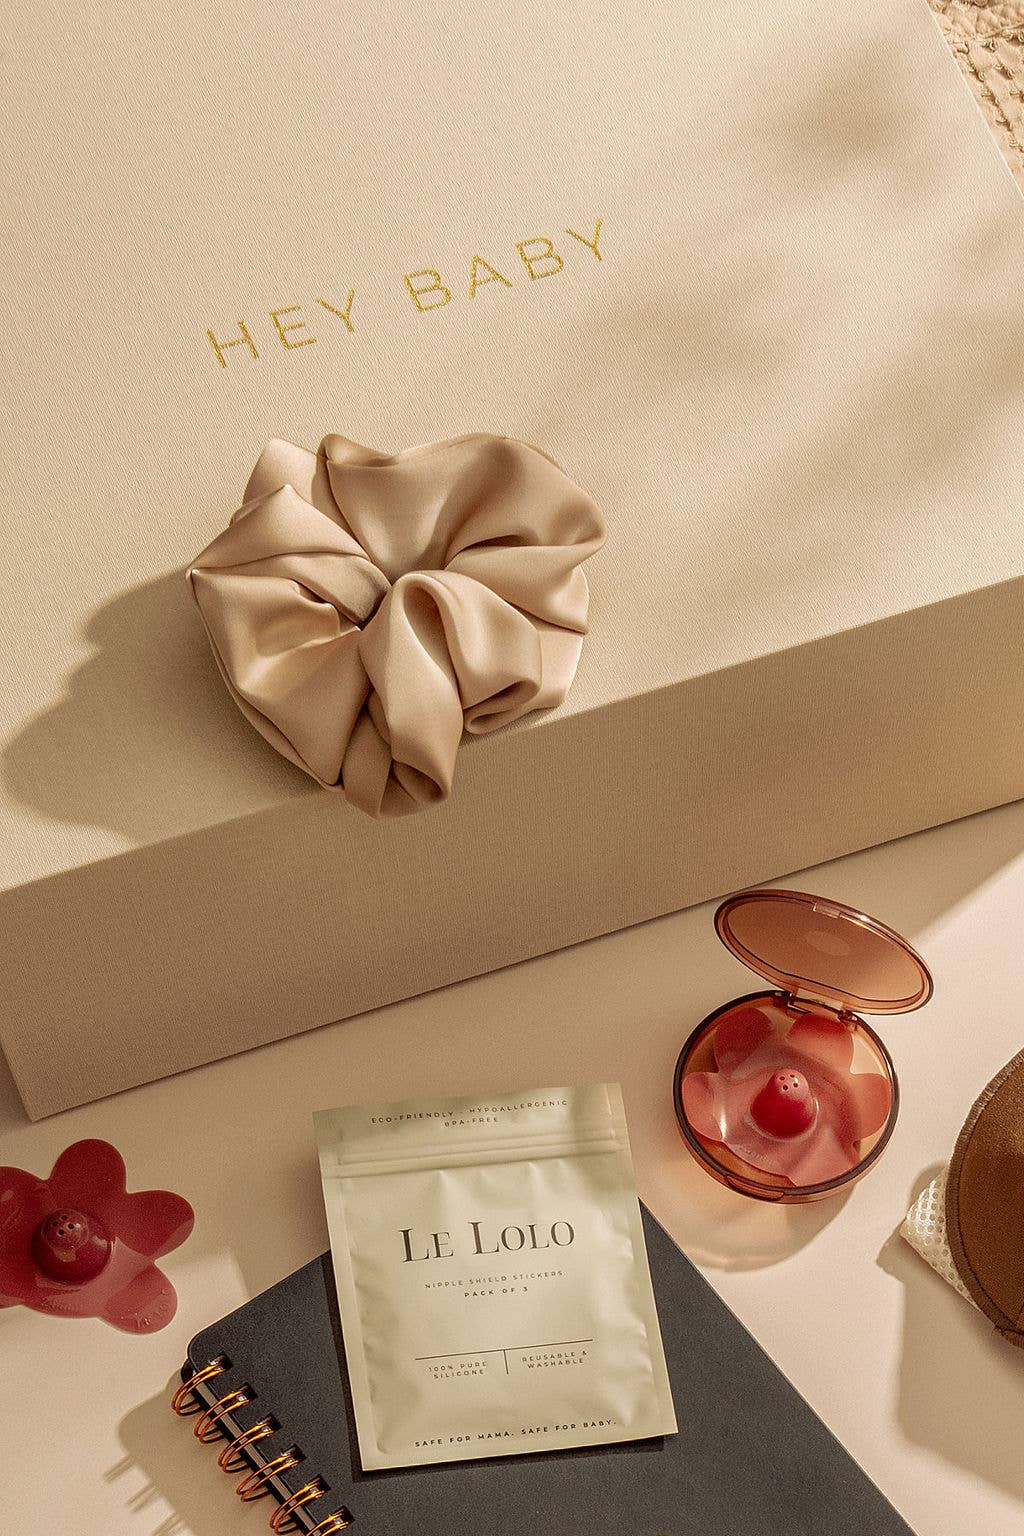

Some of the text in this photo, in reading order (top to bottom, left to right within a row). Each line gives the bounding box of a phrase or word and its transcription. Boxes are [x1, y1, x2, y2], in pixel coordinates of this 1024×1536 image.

[207, 218, 603, 369] HEY BABY
[371, 1099, 567, 1124] ECO-FRIENDLY HYPOALLERGENIC
[444, 1117, 498, 1127] BPA-FREE
[399, 1219, 576, 1263] LE LOLO
[424, 1270, 563, 1289] NIPPLE SHIELD STICKERS
[464, 1289, 494, 1297] PACK
[521, 1351, 575, 1362] REUSABLE
[459, 1361, 486, 1369] PURE
[526, 1357, 583, 1369] WASHABLE
[433, 1369, 484, 1379] SILICONE
[414, 1419, 616, 1448] SAFE FOR MAMA. SAFE FOR BABY.
